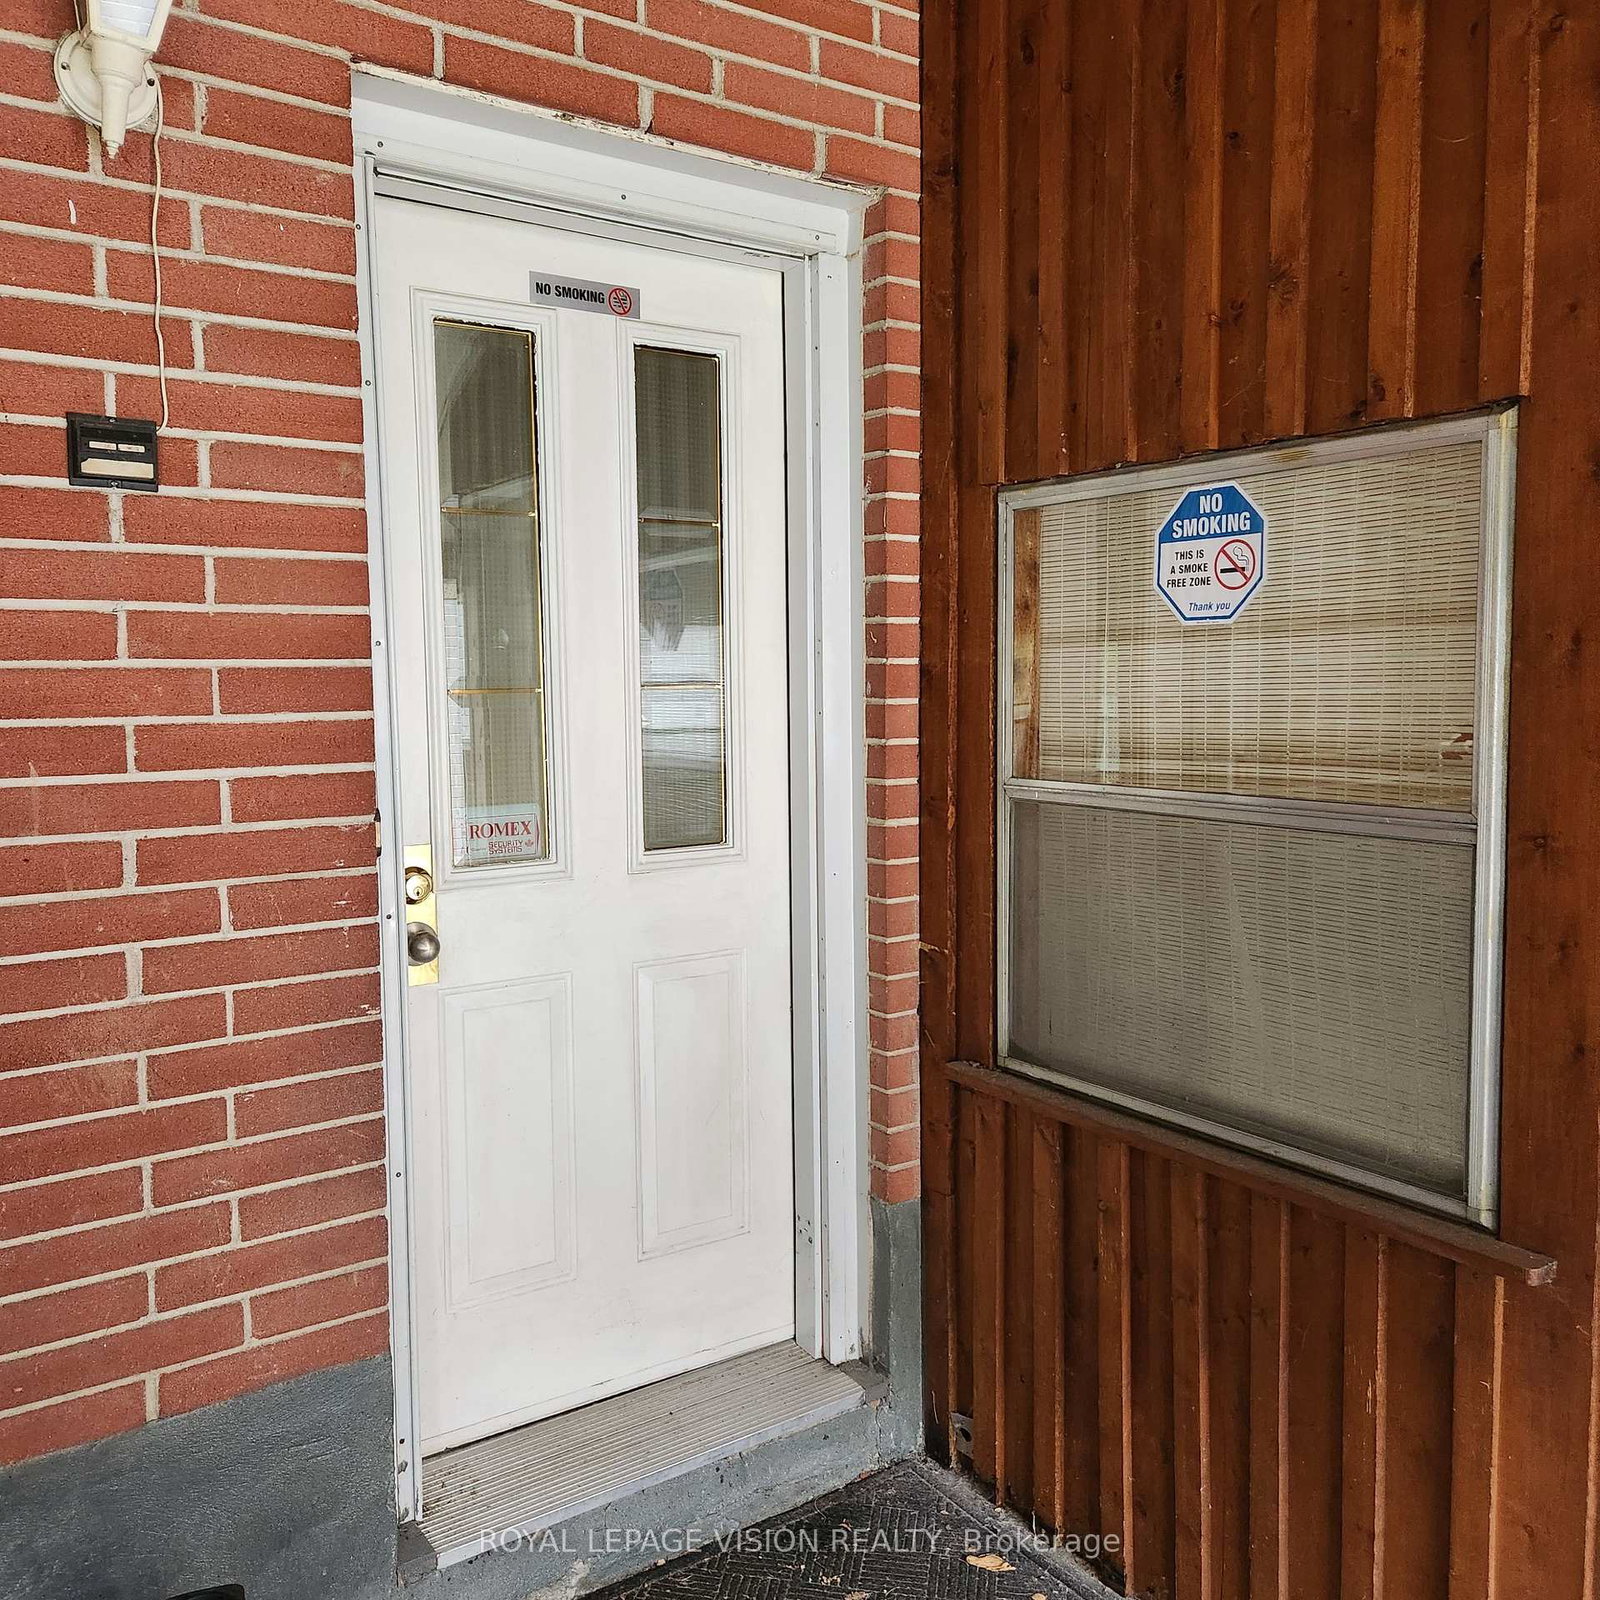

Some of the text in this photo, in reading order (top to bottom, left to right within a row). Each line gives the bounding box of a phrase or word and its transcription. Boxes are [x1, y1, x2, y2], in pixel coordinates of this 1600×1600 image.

[535, 282, 605, 304] NO SMOKING
[1199, 493, 1223, 514] NO
[1172, 511, 1251, 538] SMOKING
[1175, 549, 1204, 561] THIS IS
[1170, 563, 1208, 574] A SMOKE
[1166, 576, 1211, 588] FREE ZONE
[1188, 602, 1231, 613] Thank you
[469, 820, 531, 839] ROMEX
[489, 840, 523, 848] SECURITY
[489, 846, 523, 855] SYSTEMS
